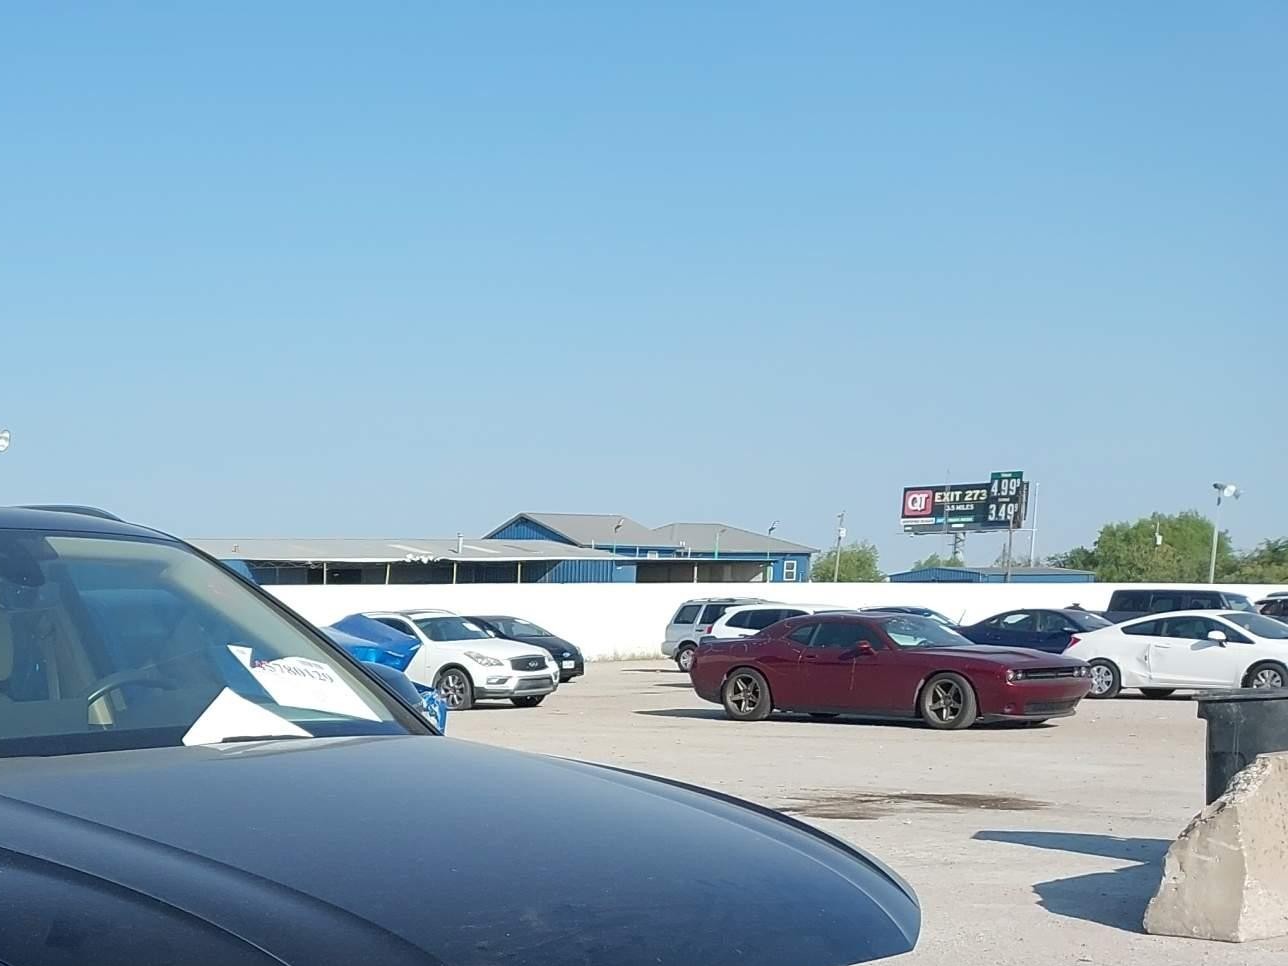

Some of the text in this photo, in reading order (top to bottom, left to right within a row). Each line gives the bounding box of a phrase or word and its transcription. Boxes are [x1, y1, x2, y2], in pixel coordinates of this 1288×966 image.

[908, 493, 928, 511] QT
[934, 491, 962, 503] EXIT
[964, 489, 988, 501] 273
[254, 660, 335, 684] 5780129
